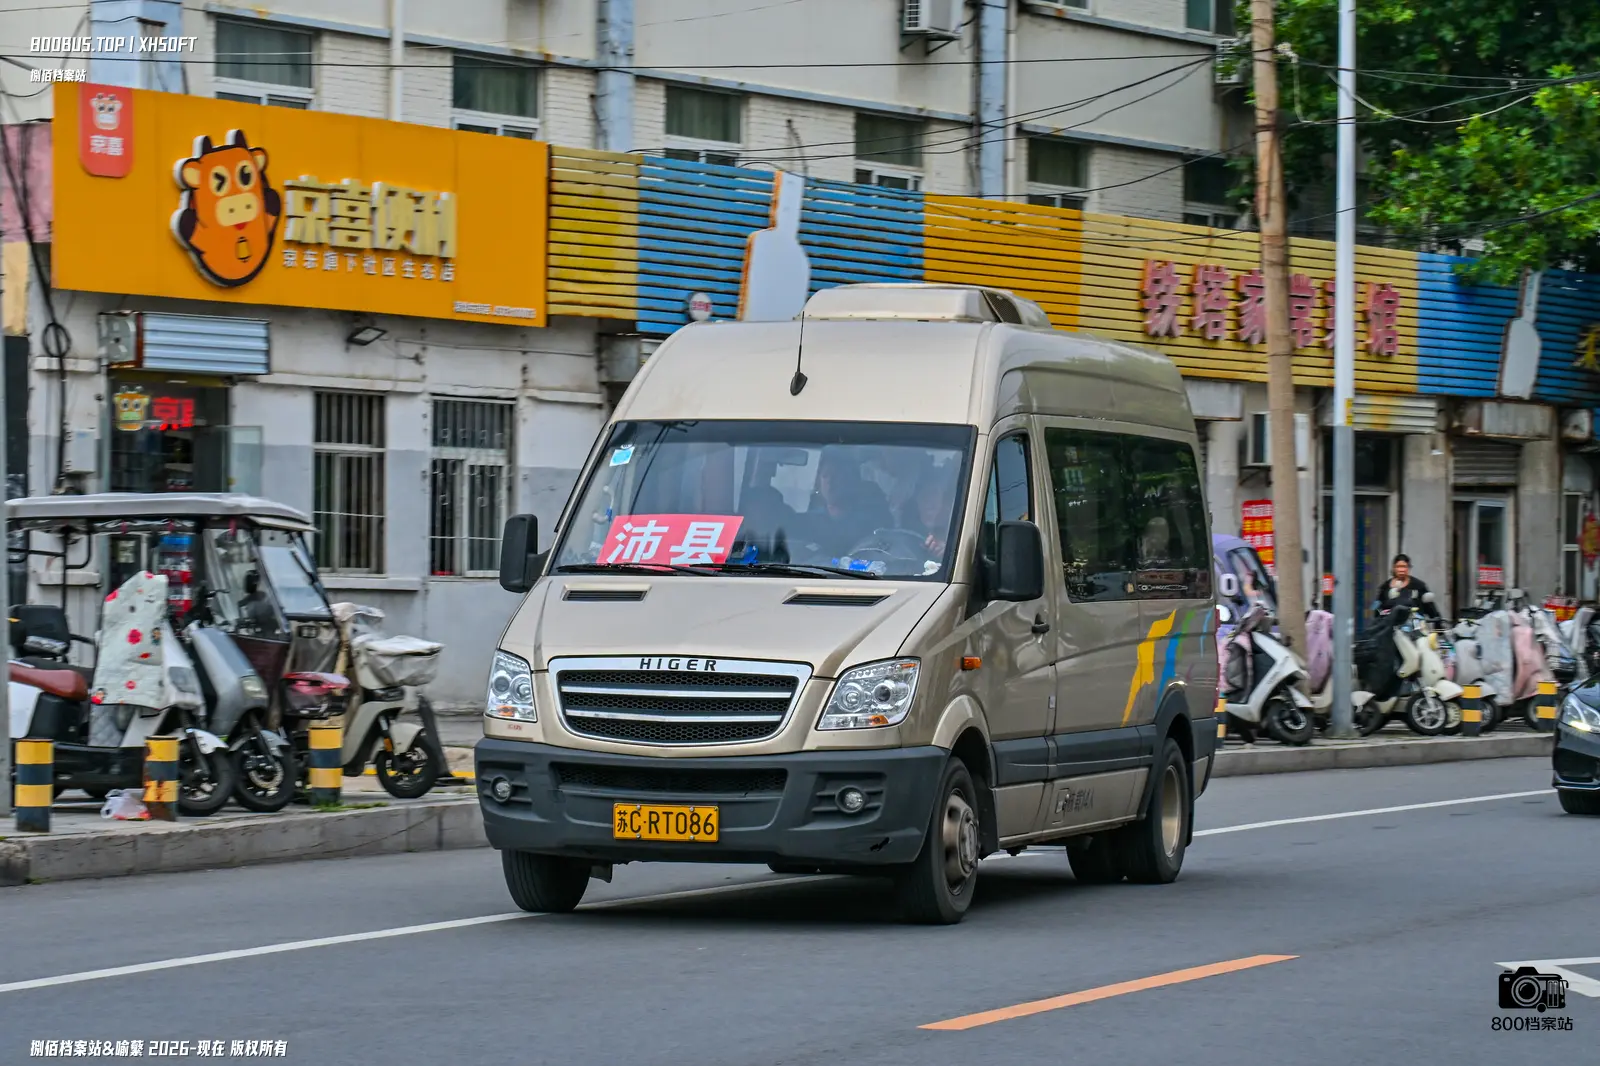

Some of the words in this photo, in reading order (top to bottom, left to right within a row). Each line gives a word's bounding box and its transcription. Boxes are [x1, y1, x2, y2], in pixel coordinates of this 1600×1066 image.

[90, 135, 125, 156] 京喜
[283, 174, 457, 259] 京喜便利
[282, 248, 456, 282] 京东旗下社区生态店
[606, 519, 725, 565] 沛县
[639, 658, 717, 672] HIGER
